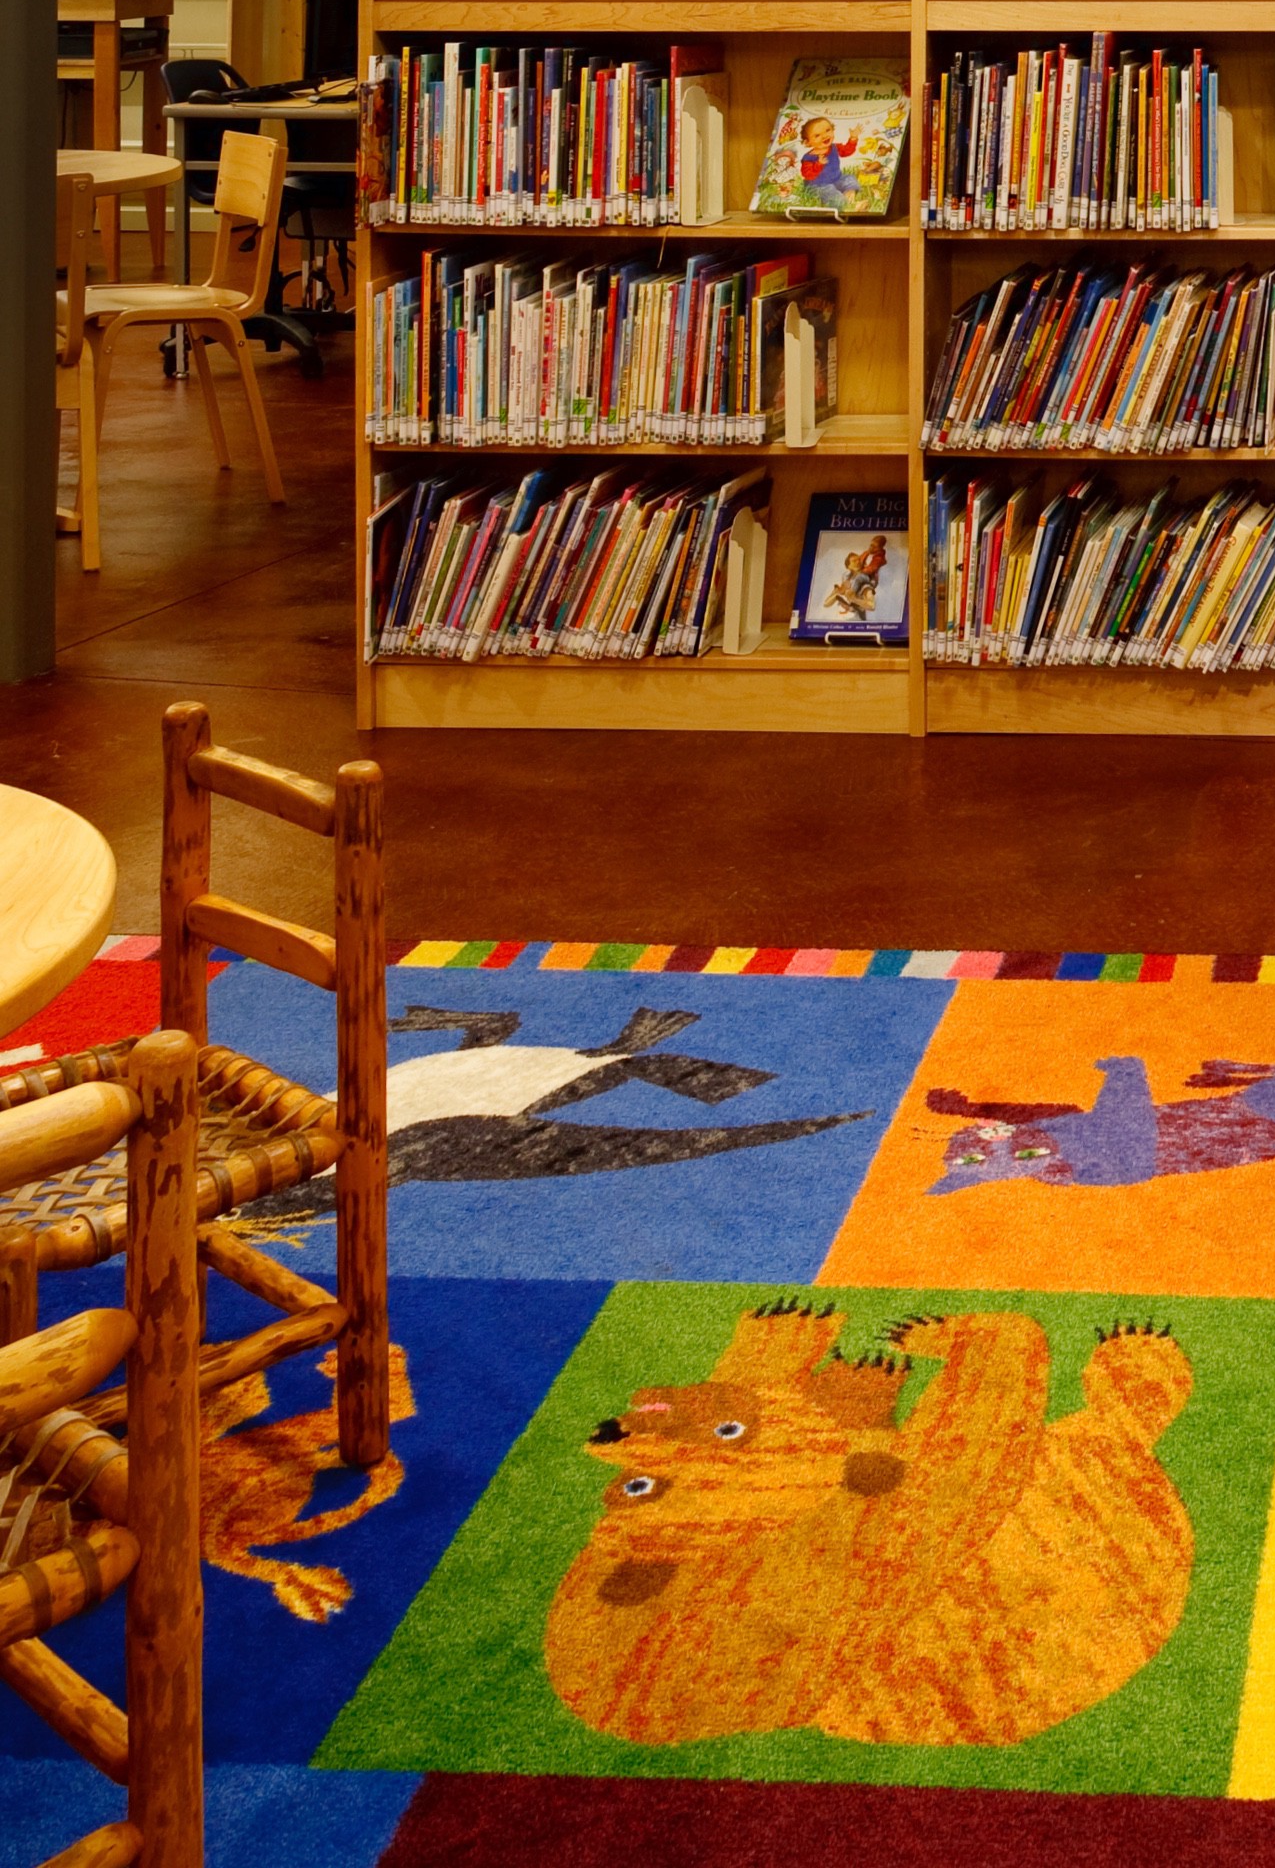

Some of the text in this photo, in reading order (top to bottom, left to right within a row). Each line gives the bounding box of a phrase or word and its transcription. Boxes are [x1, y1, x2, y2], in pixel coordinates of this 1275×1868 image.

[1066, 64, 1075, 76] Day
[801, 89, 899, 103] Playtime Book
[1060, 130, 1070, 150] GOOD
[838, 498, 904, 512] MY BIG
[830, 514, 908, 528] BROTHER
